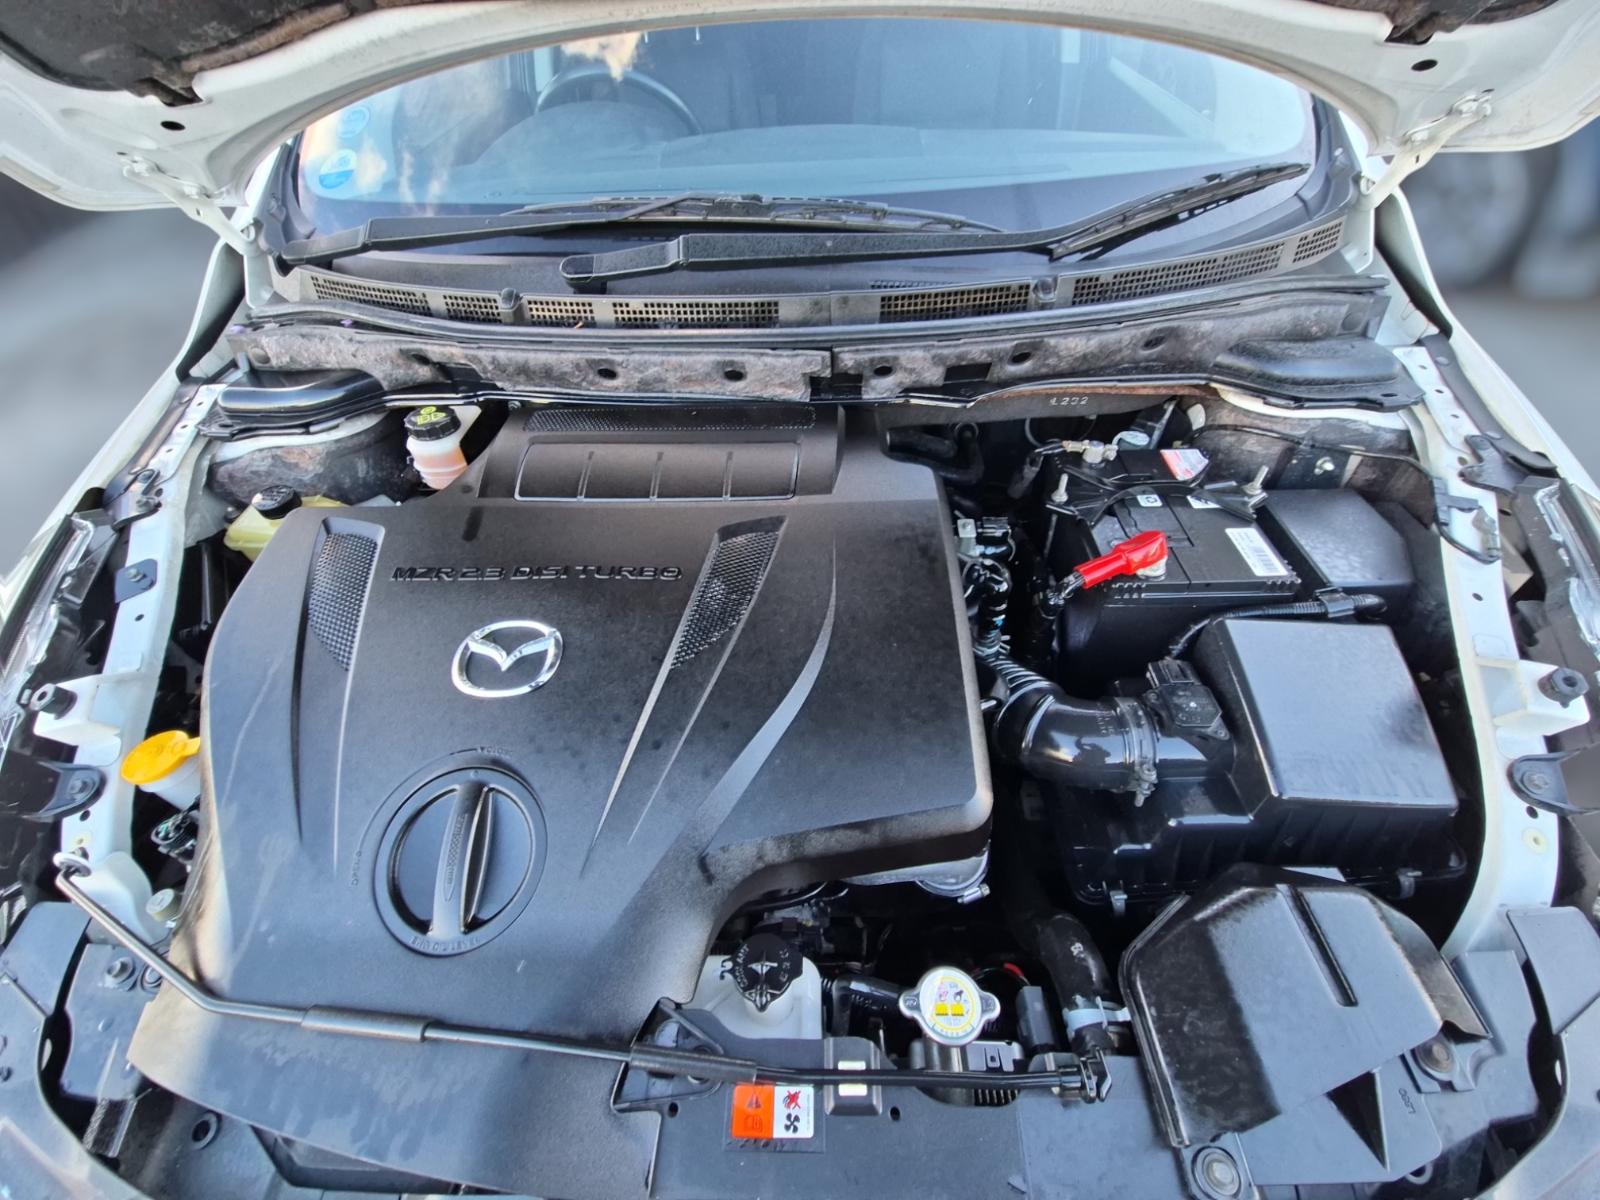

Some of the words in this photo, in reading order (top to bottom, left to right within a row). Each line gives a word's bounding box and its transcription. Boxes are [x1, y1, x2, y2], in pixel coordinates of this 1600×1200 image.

[390, 566, 456, 581] MZR
[458, 566, 505, 581] 2.3
[575, 564, 683, 581] TURBO
